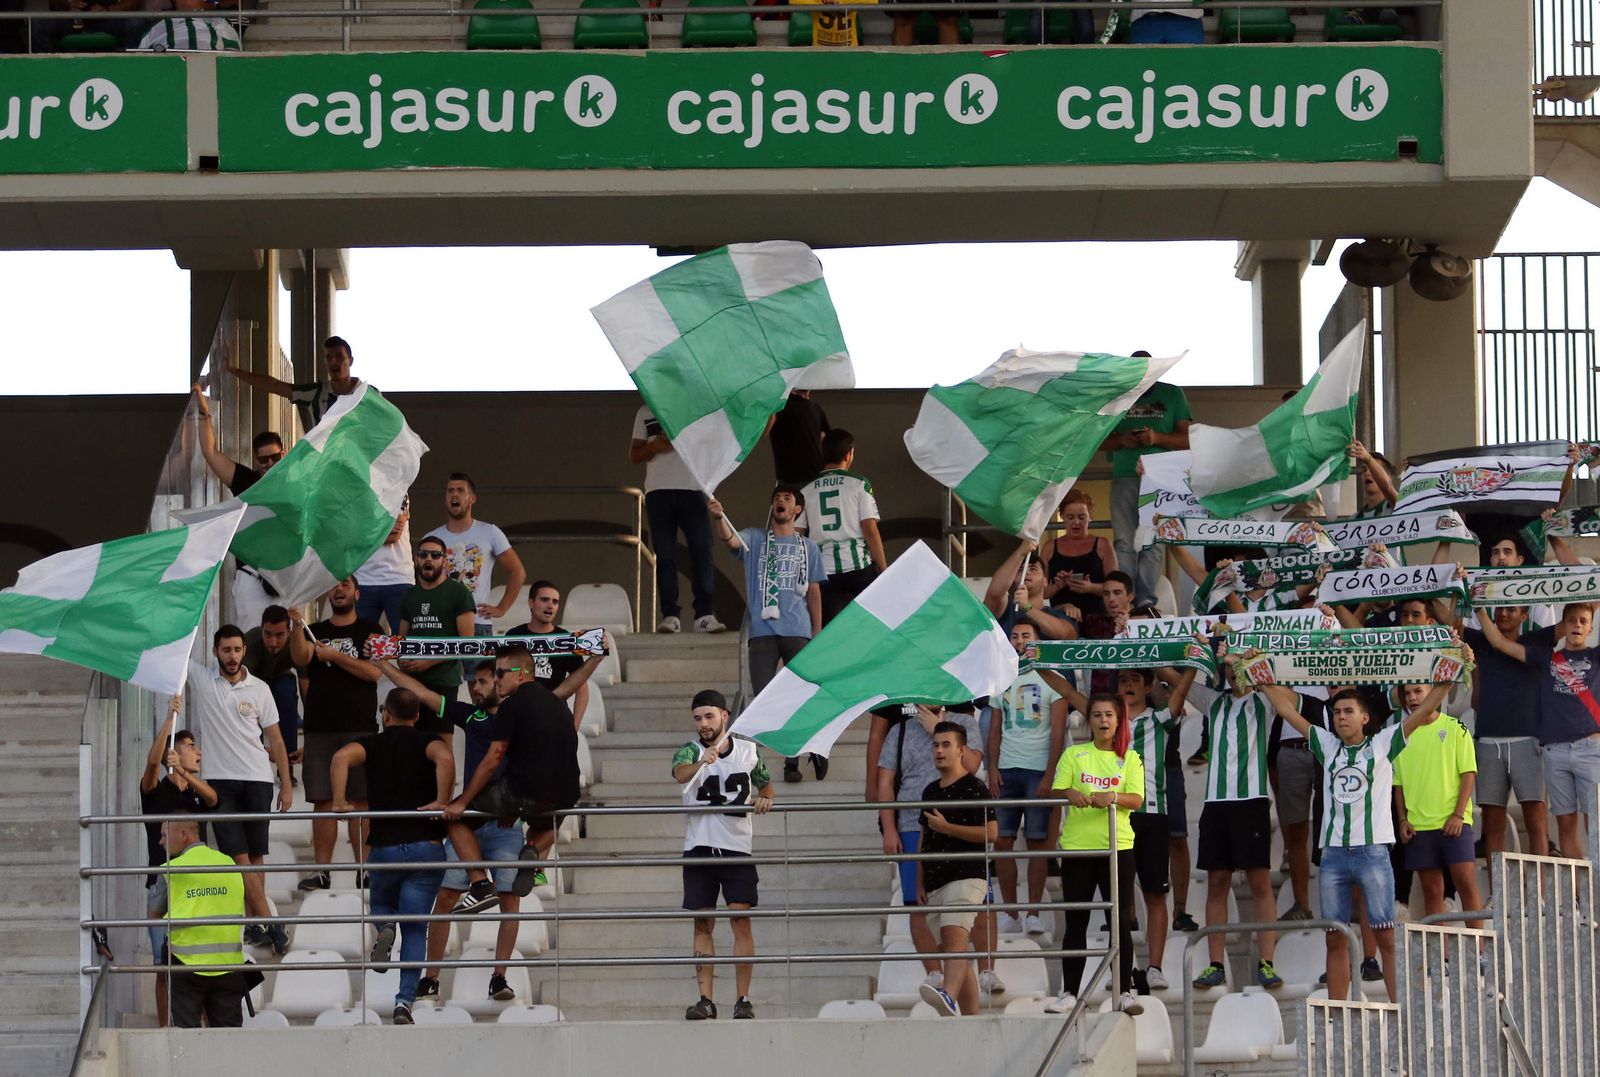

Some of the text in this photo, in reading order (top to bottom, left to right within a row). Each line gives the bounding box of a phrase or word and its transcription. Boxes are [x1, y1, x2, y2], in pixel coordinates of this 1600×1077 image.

[284, 74, 555, 148] cajasur
[667, 73, 935, 148] cajasur
[1057, 69, 1326, 144] cajasur
[819, 489, 841, 531] 5
[1197, 521, 1276, 537] CÓRDOBA
[1333, 567, 1438, 592] CÓRDOBA
[1138, 615, 1315, 639] RAZAK BRIMAH
[1062, 642, 1160, 661] CÓRDOBA
[1226, 632, 1311, 649] ULTRAS
[1293, 654, 1415, 668] ¡HEMOS VUELTO!
[1308, 667, 1397, 676] SOMOS DE PRIMERA
[696, 772, 750, 818] 42
[186, 887, 228, 898] SEGURIDAD
